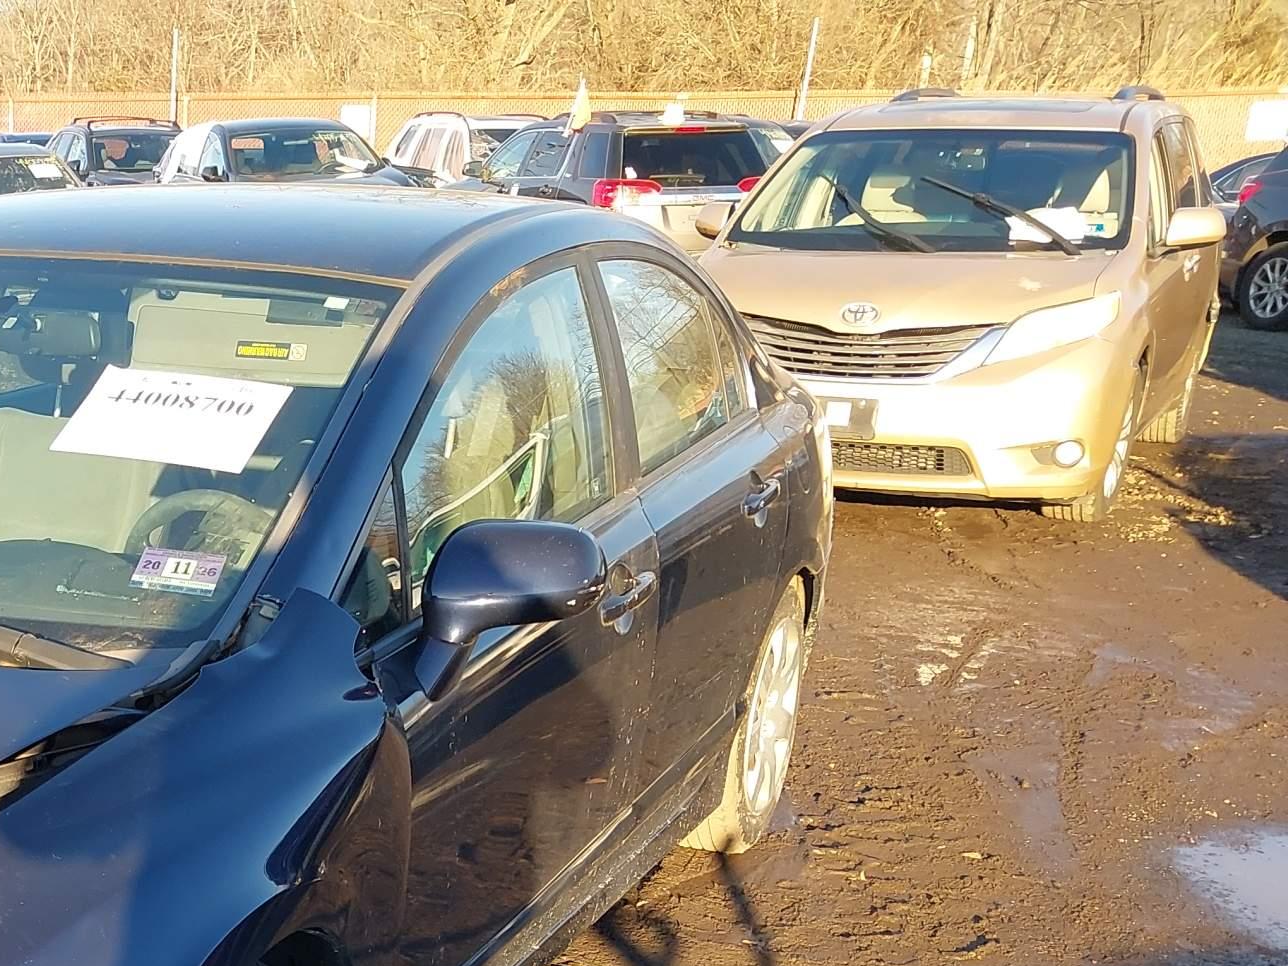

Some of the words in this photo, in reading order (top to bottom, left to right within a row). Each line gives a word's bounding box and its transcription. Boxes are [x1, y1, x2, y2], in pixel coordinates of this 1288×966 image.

[108, 389, 254, 416] 44008700
[143, 560, 161, 570] 20
[170, 561, 191, 574] 11
